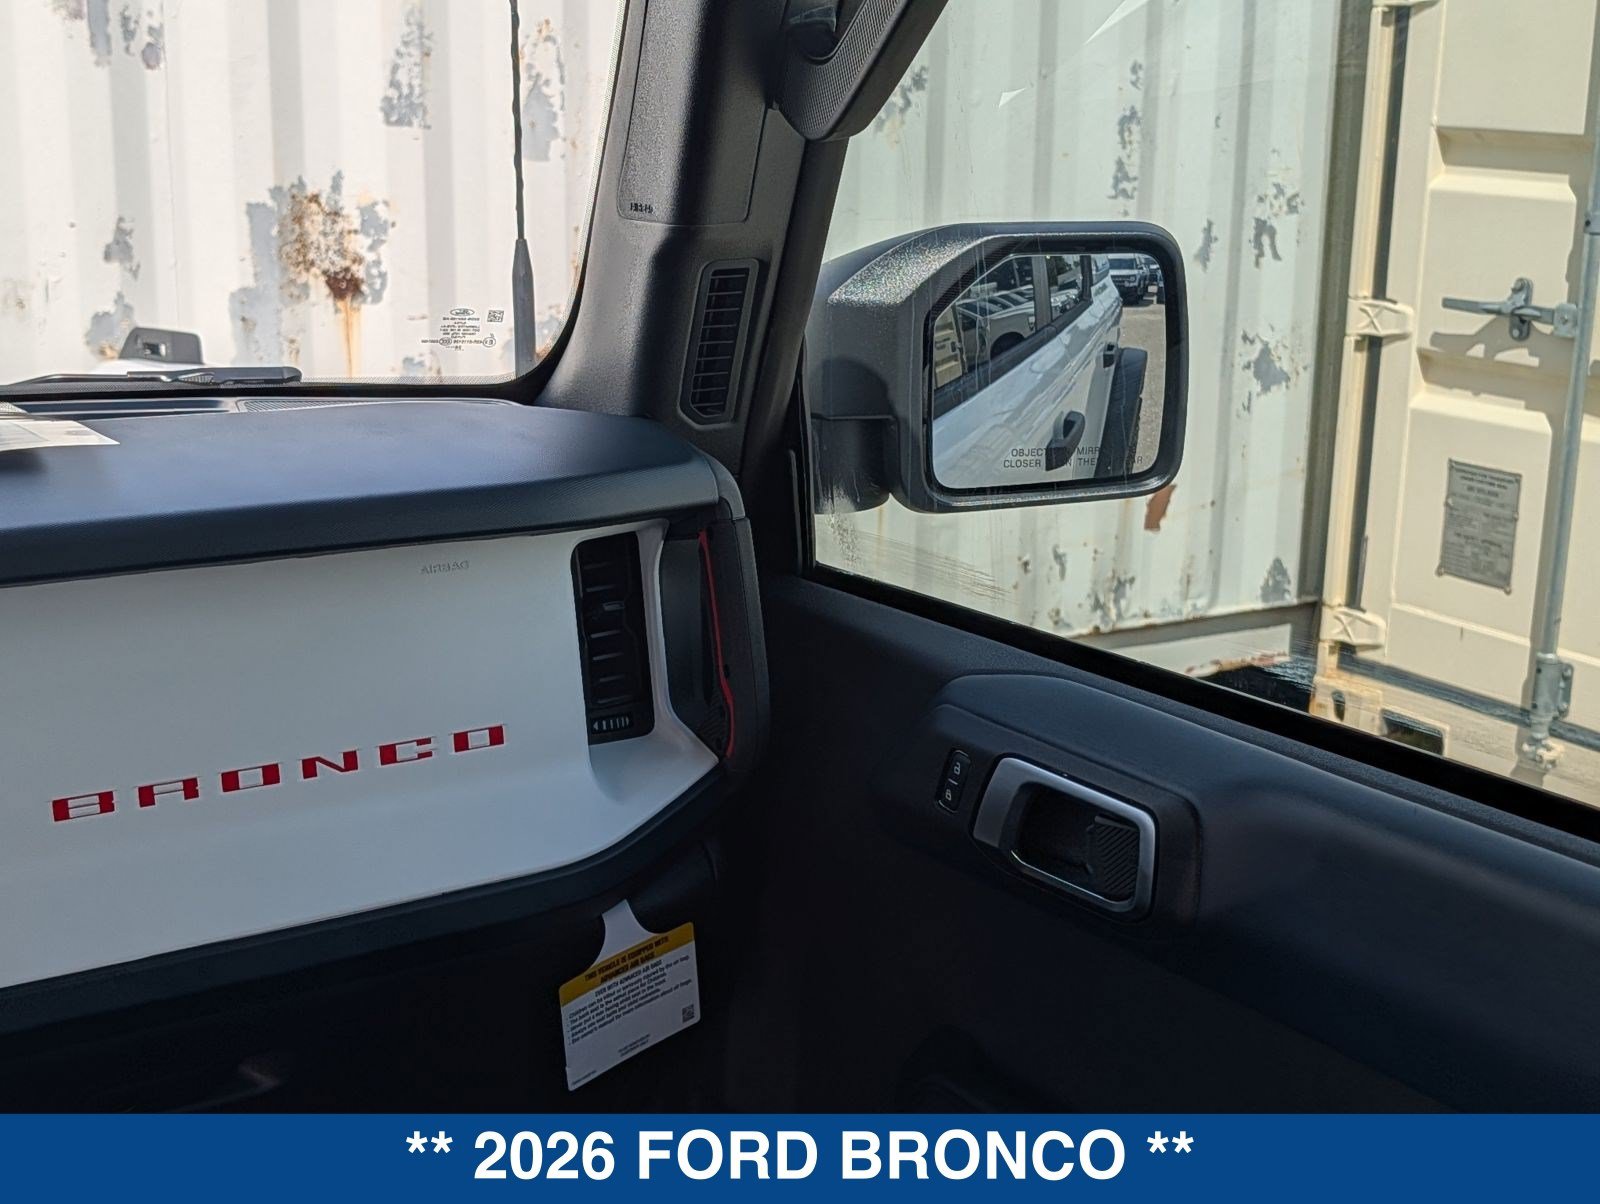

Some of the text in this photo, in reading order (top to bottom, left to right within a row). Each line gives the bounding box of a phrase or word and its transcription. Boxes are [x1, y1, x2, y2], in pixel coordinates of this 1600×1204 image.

[1003, 459, 1041, 468] CLOSER
[1077, 457, 1096, 466] THE
[52, 725, 504, 821] BRONCO
